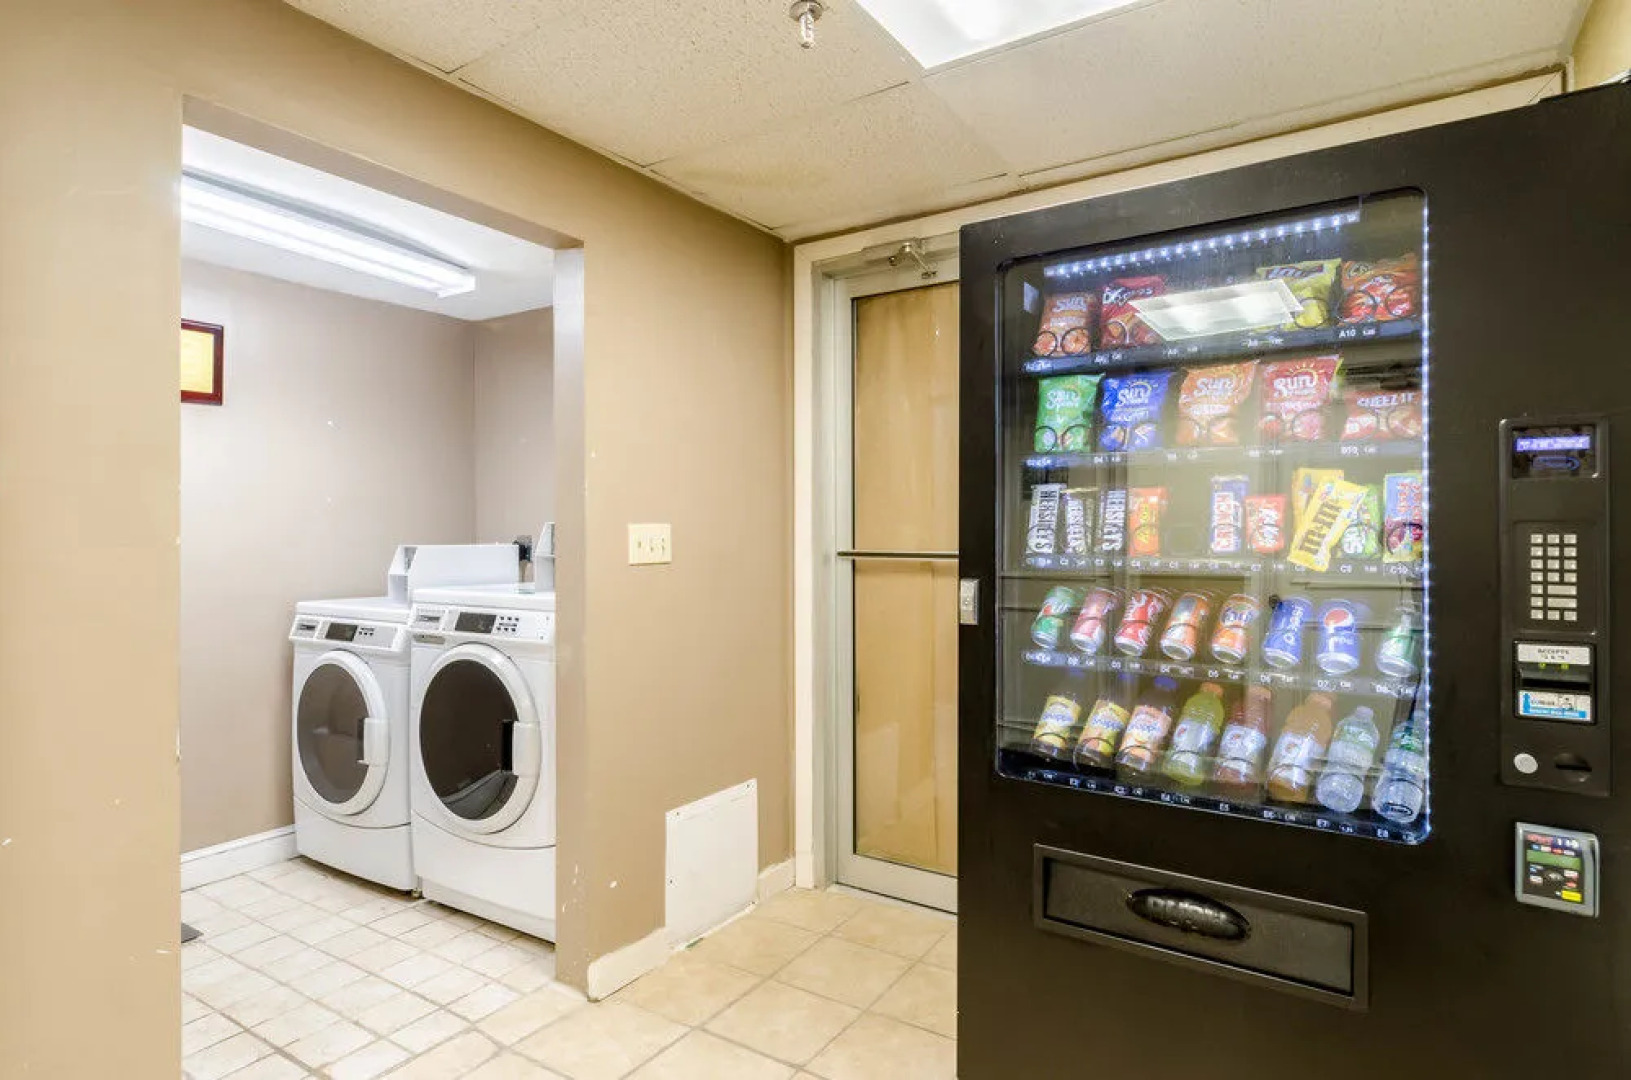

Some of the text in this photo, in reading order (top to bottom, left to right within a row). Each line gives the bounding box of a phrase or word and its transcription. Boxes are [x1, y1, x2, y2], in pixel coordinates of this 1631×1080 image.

[1340, 328, 1357, 339] A10
[1117, 385, 1151, 407] Sun
[1193, 377, 1233, 398] Sun
[1273, 375, 1316, 398] Sun
